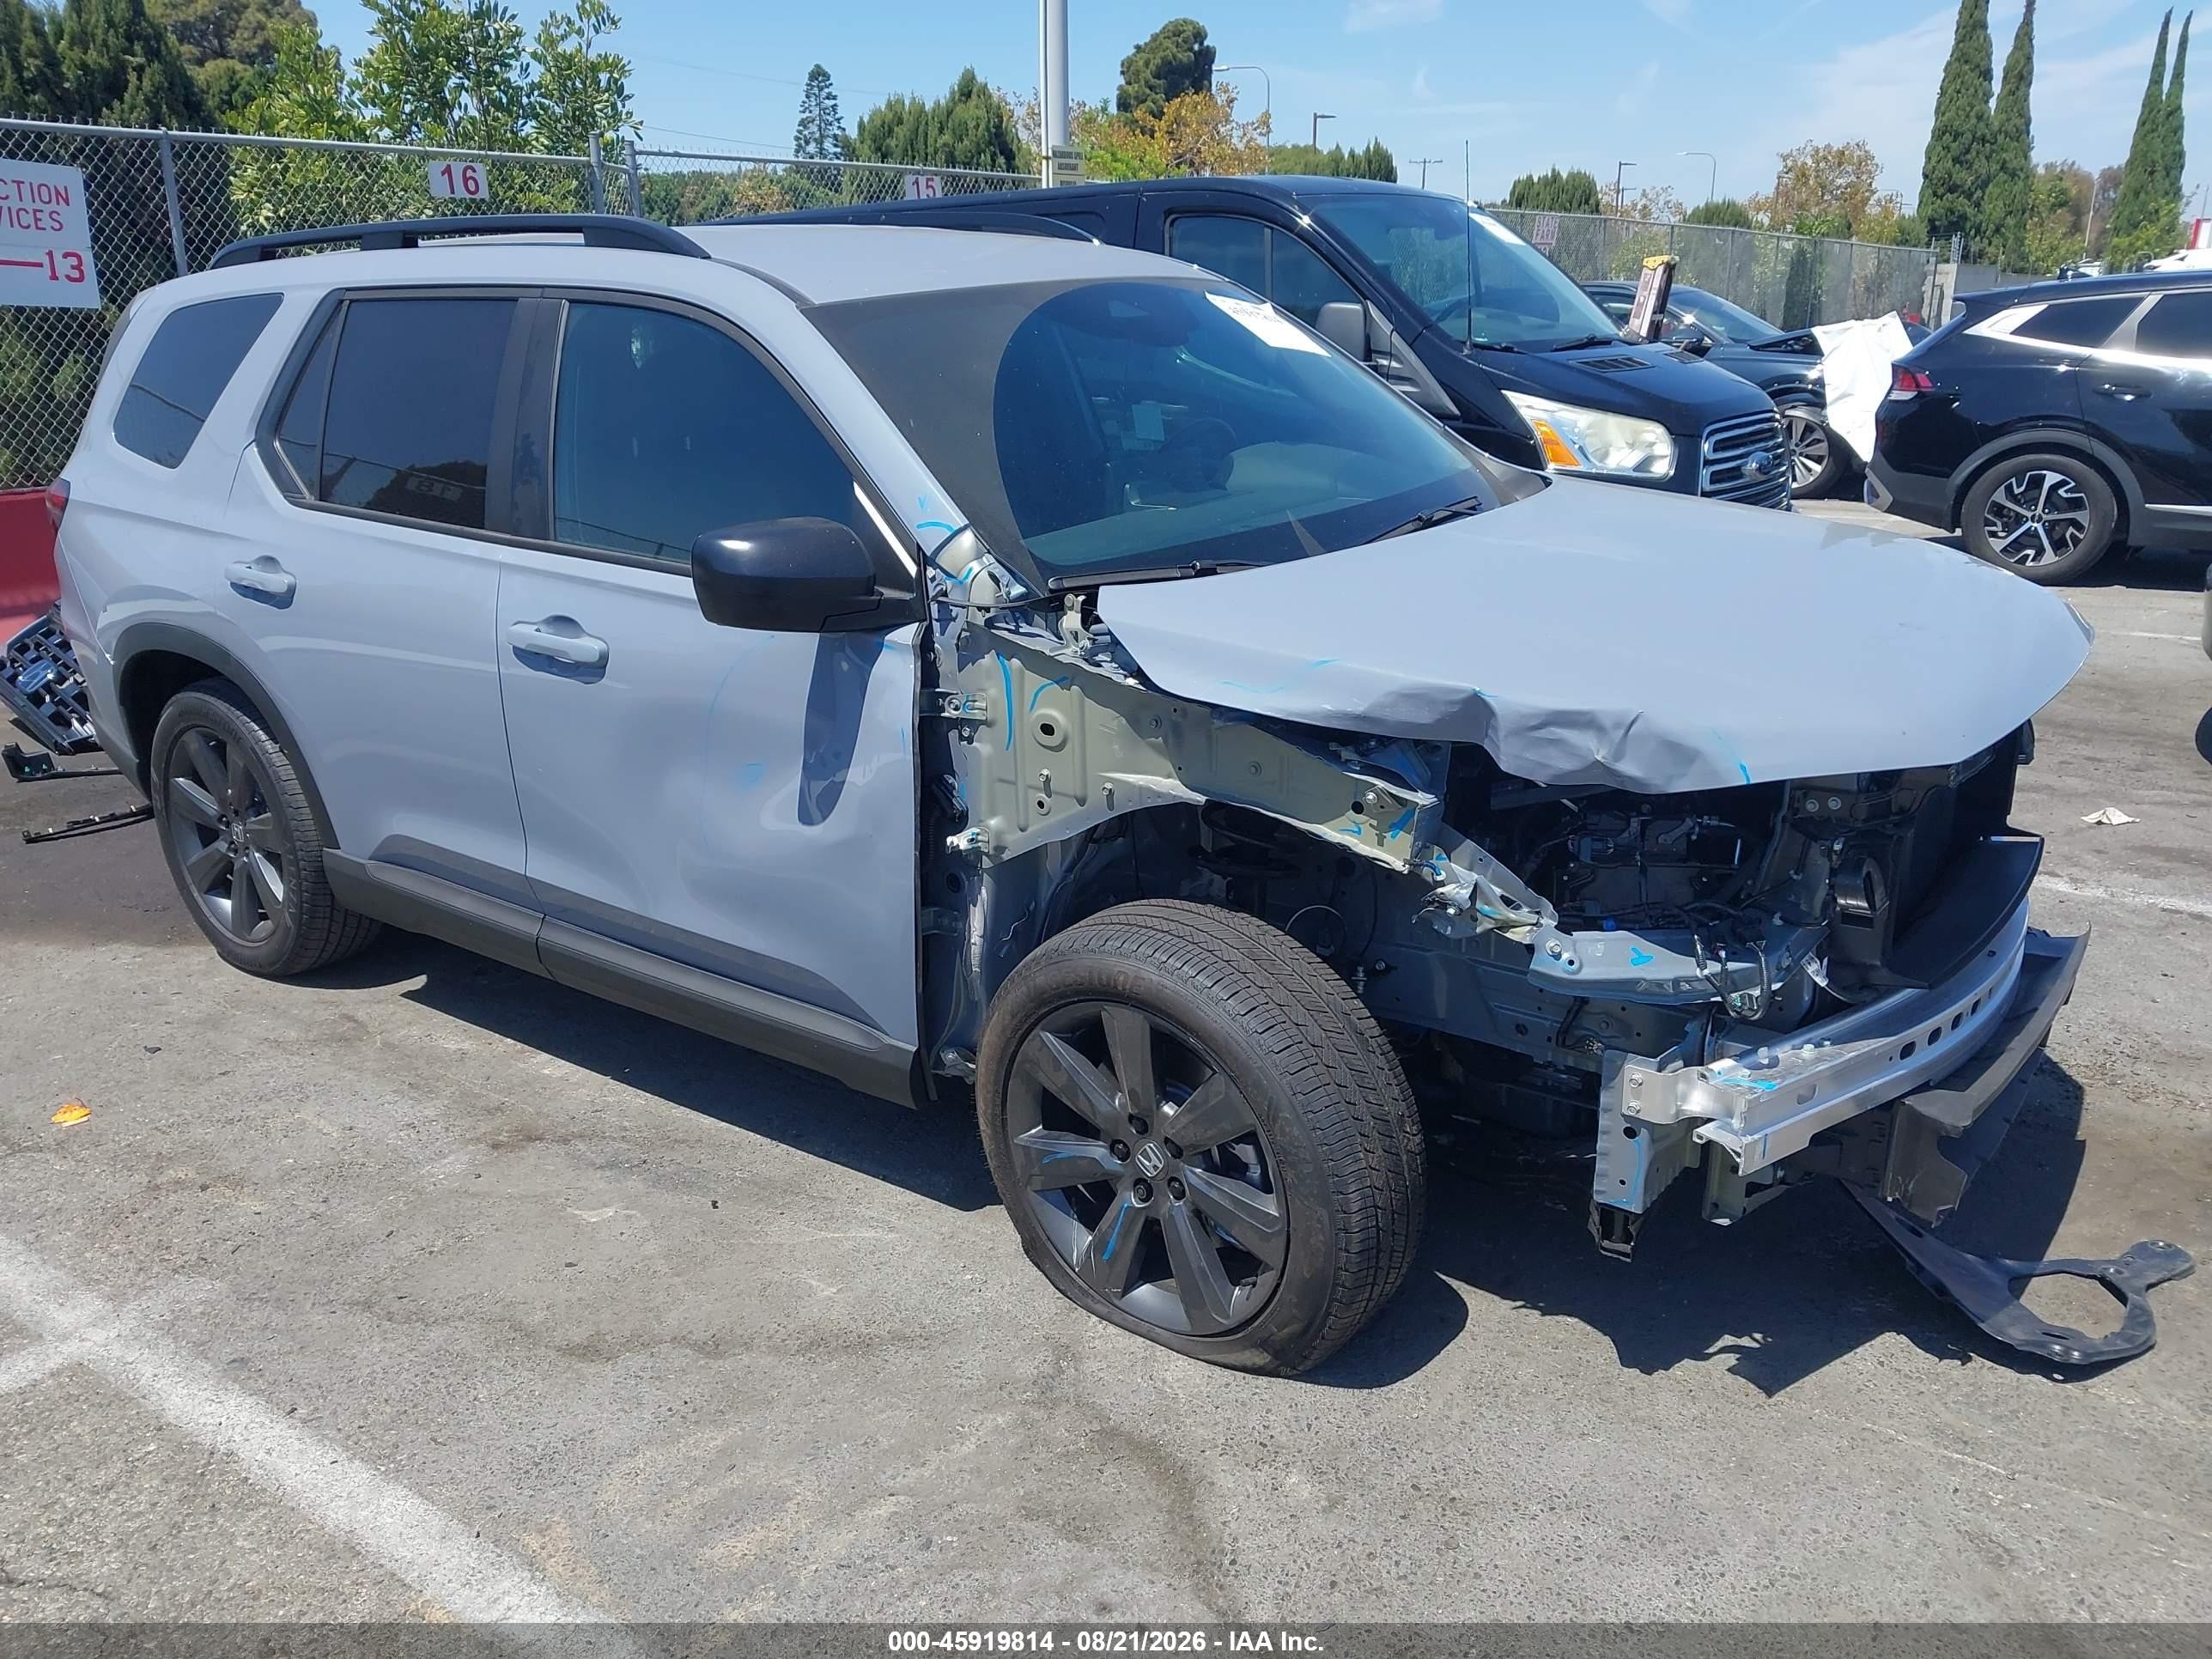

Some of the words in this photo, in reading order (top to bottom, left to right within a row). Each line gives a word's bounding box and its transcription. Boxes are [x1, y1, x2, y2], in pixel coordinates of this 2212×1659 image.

[441, 164, 480, 196] 16
[912, 176, 936, 199] 15
[0, 205, 64, 232] ICES
[1537, 216, 1559, 228] STATE
